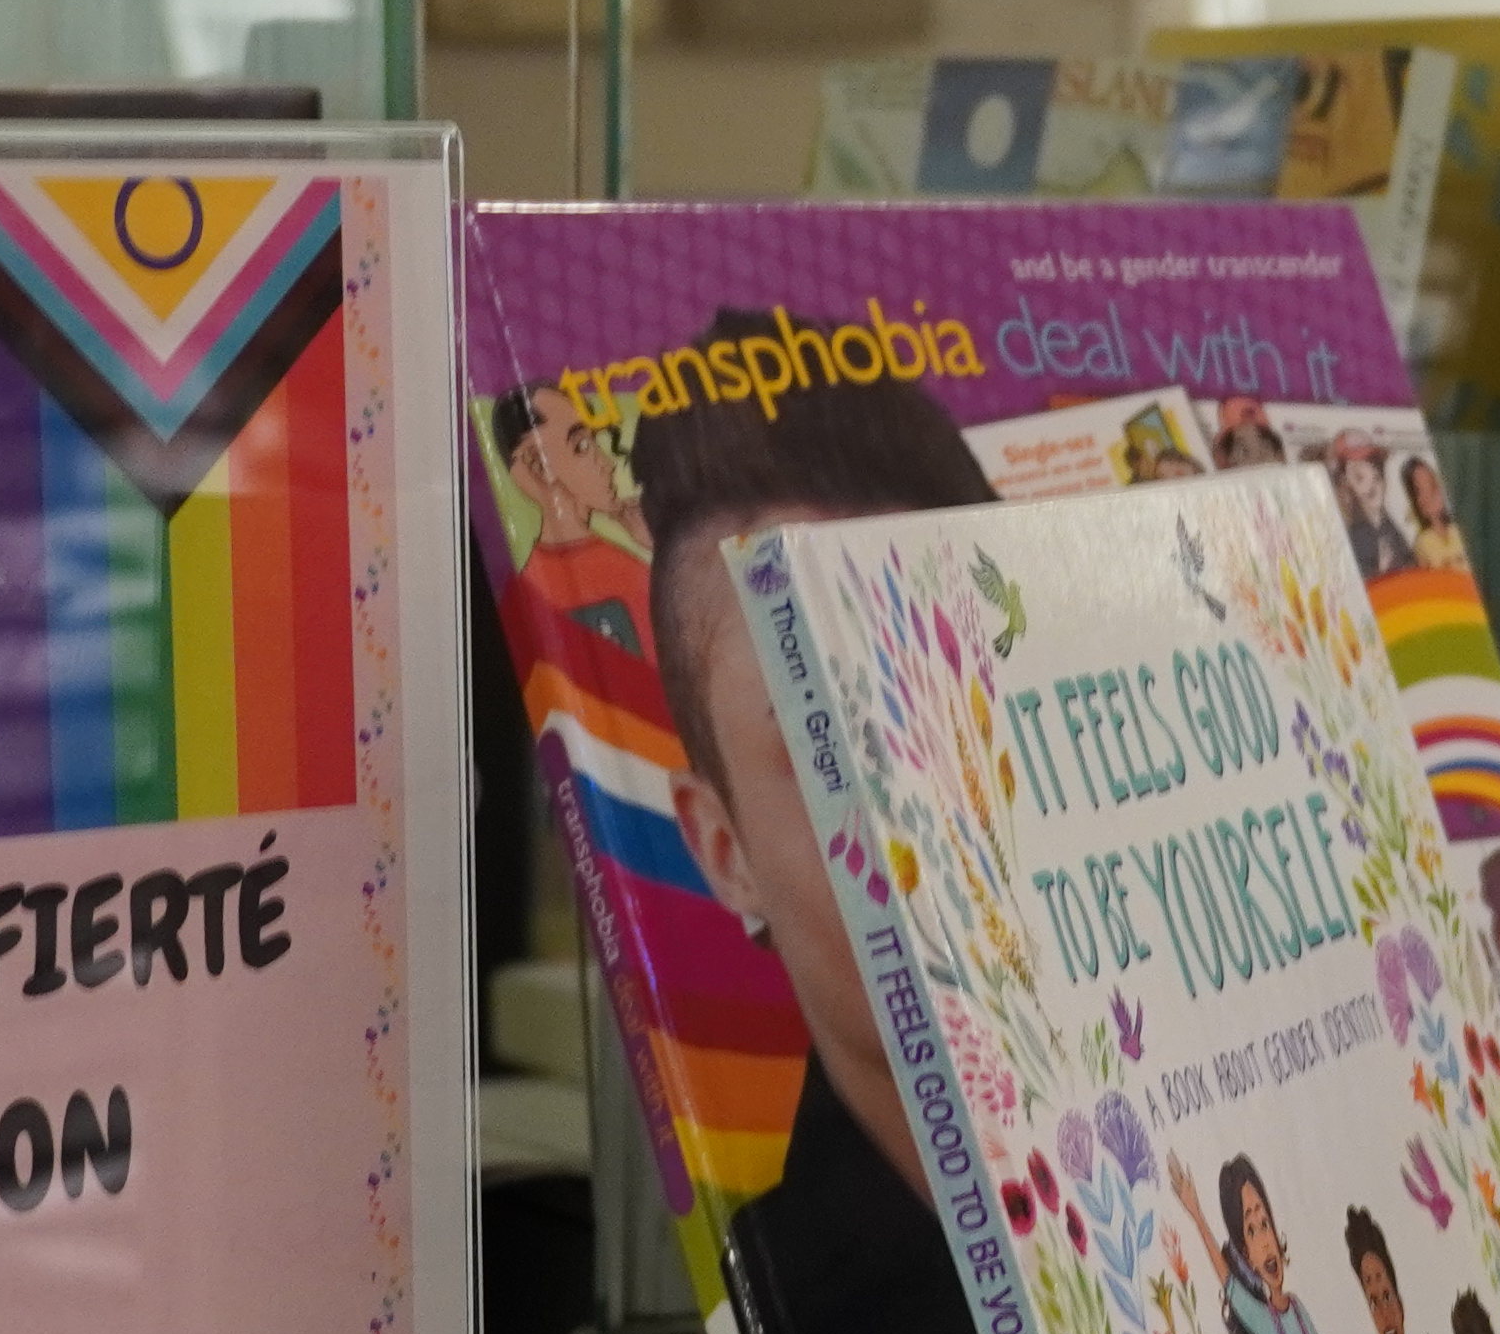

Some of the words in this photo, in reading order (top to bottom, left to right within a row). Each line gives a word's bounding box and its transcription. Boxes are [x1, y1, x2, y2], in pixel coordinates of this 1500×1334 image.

[557, 298, 984, 432] transphobia
[997, 295, 1135, 381] deal
[1143, 309, 1289, 395] with
[1303, 327, 1349, 407] it
[804, 708, 850, 797] Grigni
[1003, 687, 1067, 817] IT
[1053, 663, 1186, 809] FEELS
[1171, 640, 1280, 777] GOOD
[864, 923, 904, 961] IT
[1032, 867, 1101, 986] TO
[1083, 842, 1153, 970] BE
[1127, 790, 1357, 1000] YOURSELF
[876, 966, 936, 1069] FEELS
[1146, 1085, 1165, 1132] A
[1159, 1061, 1211, 1122] BOOK
[1213, 1044, 1264, 1104] ABOUT
[1263, 1019, 1326, 1088] GENDER
[1323, 992, 1387, 1058] IDENTITY
[913, 1069, 971, 1178] GOOD
[950, 1178, 989, 1232] TO
[966, 1236, 1009, 1284] BE
